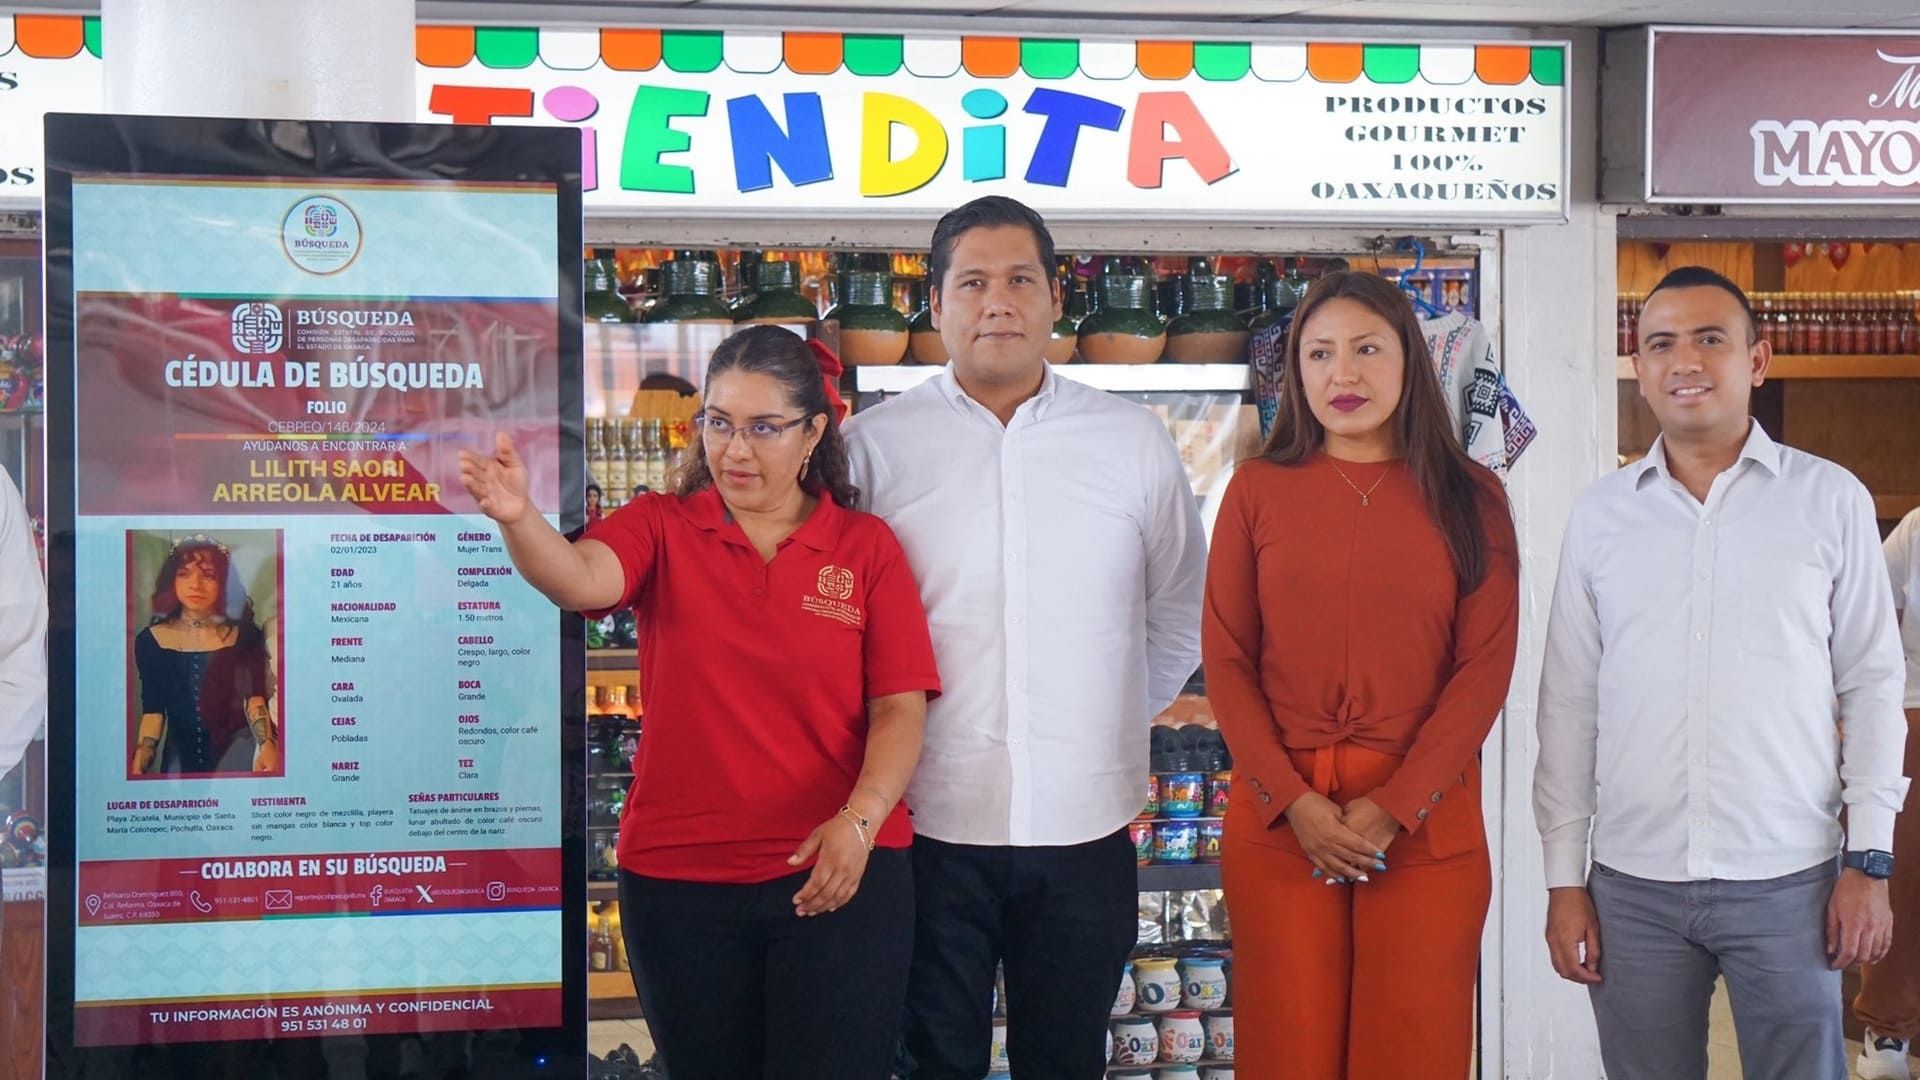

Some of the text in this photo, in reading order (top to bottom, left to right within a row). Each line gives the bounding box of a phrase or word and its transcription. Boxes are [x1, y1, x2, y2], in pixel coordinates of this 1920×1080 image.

[1325, 96, 1548, 116] PRODUCTOS
[1344, 125, 1527, 144] GOURMET
[1392, 154, 1484, 172] 100%
[1311, 178, 1558, 202] OAXAQUEÑOS
[294, 238, 350, 249] BÚSQUEDA
[297, 307, 415, 327] BÚSQUEDA
[165, 355, 484, 392] CÉDULA DE BÚSQUEDA
[307, 401, 347, 414] FOLIO
[268, 421, 386, 434] CEBPEO/146/2024
[311, 441, 320, 451] A
[322, 441, 396, 451] ENCONTRAR
[398, 441, 407, 451] A
[250, 460, 405, 478] LILITH SAORI
[212, 483, 441, 502] ARREOLA ALVEAR
[331, 532, 436, 542] FECHA DE DESAPARICIÓN
[457, 531, 491, 542] GÉNERO
[331, 546, 377, 554] 02/01/2023
[457, 545, 502, 554] Mujer Trans
[331, 569, 354, 577] EDAD
[457, 566, 512, 576] COMPLEXIÓN
[457, 580, 489, 588] Delgada
[331, 603, 396, 611] NACIONALIDAD
[458, 602, 501, 610] ESTATURA
[803, 595, 861, 615] BÚSQUEDA
[331, 615, 369, 623] Mexicana
[458, 614, 504, 622] 1.50 metros
[331, 638, 363, 646] FRENTE
[458, 636, 494, 645] CABELLO
[458, 647, 530, 657] Crespo, largo, color
[458, 659, 480, 667] negro
[331, 683, 354, 691] CARA
[458, 681, 481, 689] BOCA
[331, 695, 363, 703] Ovalada
[458, 692, 486, 700] Grande
[331, 718, 356, 726] CEJAS
[458, 715, 480, 723] OJOS
[458, 726, 538, 736] Redondos, color café
[332, 735, 368, 743] Pobladas
[331, 762, 359, 770] NARIZ
[458, 760, 474, 768] TEZ
[332, 774, 360, 782] Grande
[458, 771, 479, 779] Clara
[251, 797, 306, 806] VESTIMENTA
[408, 792, 500, 802] SEÑAS PARTICULARES
[107, 798, 219, 810] LUGAR DE DESAPARICIÓN
[295, 811, 316, 819] negro
[368, 809, 394, 817] playera
[409, 807, 438, 815] Tatuajes
[515, 805, 542, 813] piernas,
[107, 815, 127, 824] Playa
[164, 813, 200, 822] Municipio
[266, 823, 295, 831] mangas
[408, 830, 432, 838] debajo
[202, 854, 446, 879] COLABORA EN SU BÚSQUEDA
[151, 999, 494, 1023] TU INFORMACIÓN ES ANÓNIMA Y CONFIDENCIAL
[281, 1018, 367, 1032] 951 531 48 01
